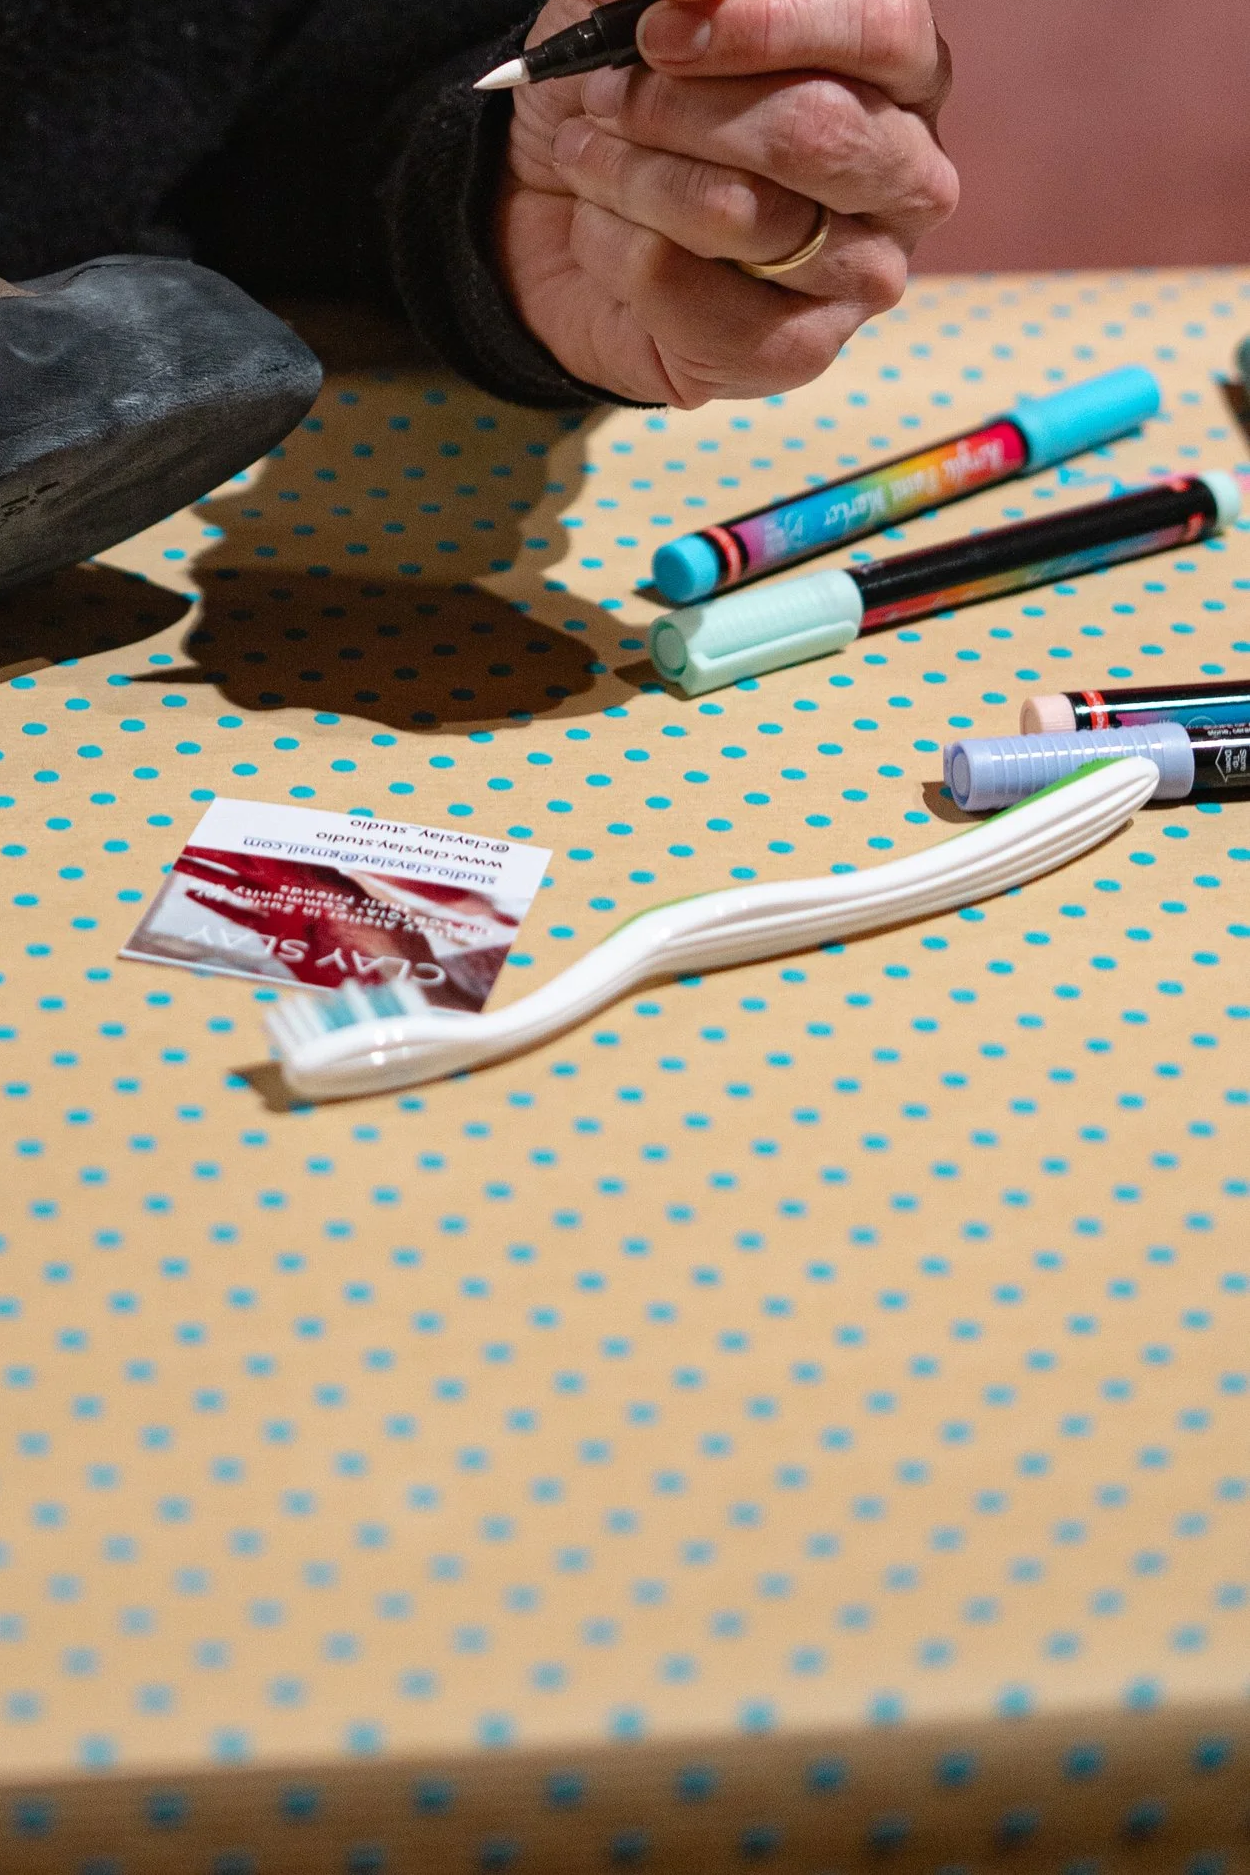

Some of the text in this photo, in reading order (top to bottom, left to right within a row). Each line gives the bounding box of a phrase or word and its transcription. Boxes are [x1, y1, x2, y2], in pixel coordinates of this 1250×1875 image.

[316, 832, 502, 869] www.clayslay.studio
[350, 819, 510, 853] @clayslay_studio
[243, 836, 497, 885] studio.clayslay@gmail.com
[185, 926, 447, 987] CLAY SLAY
